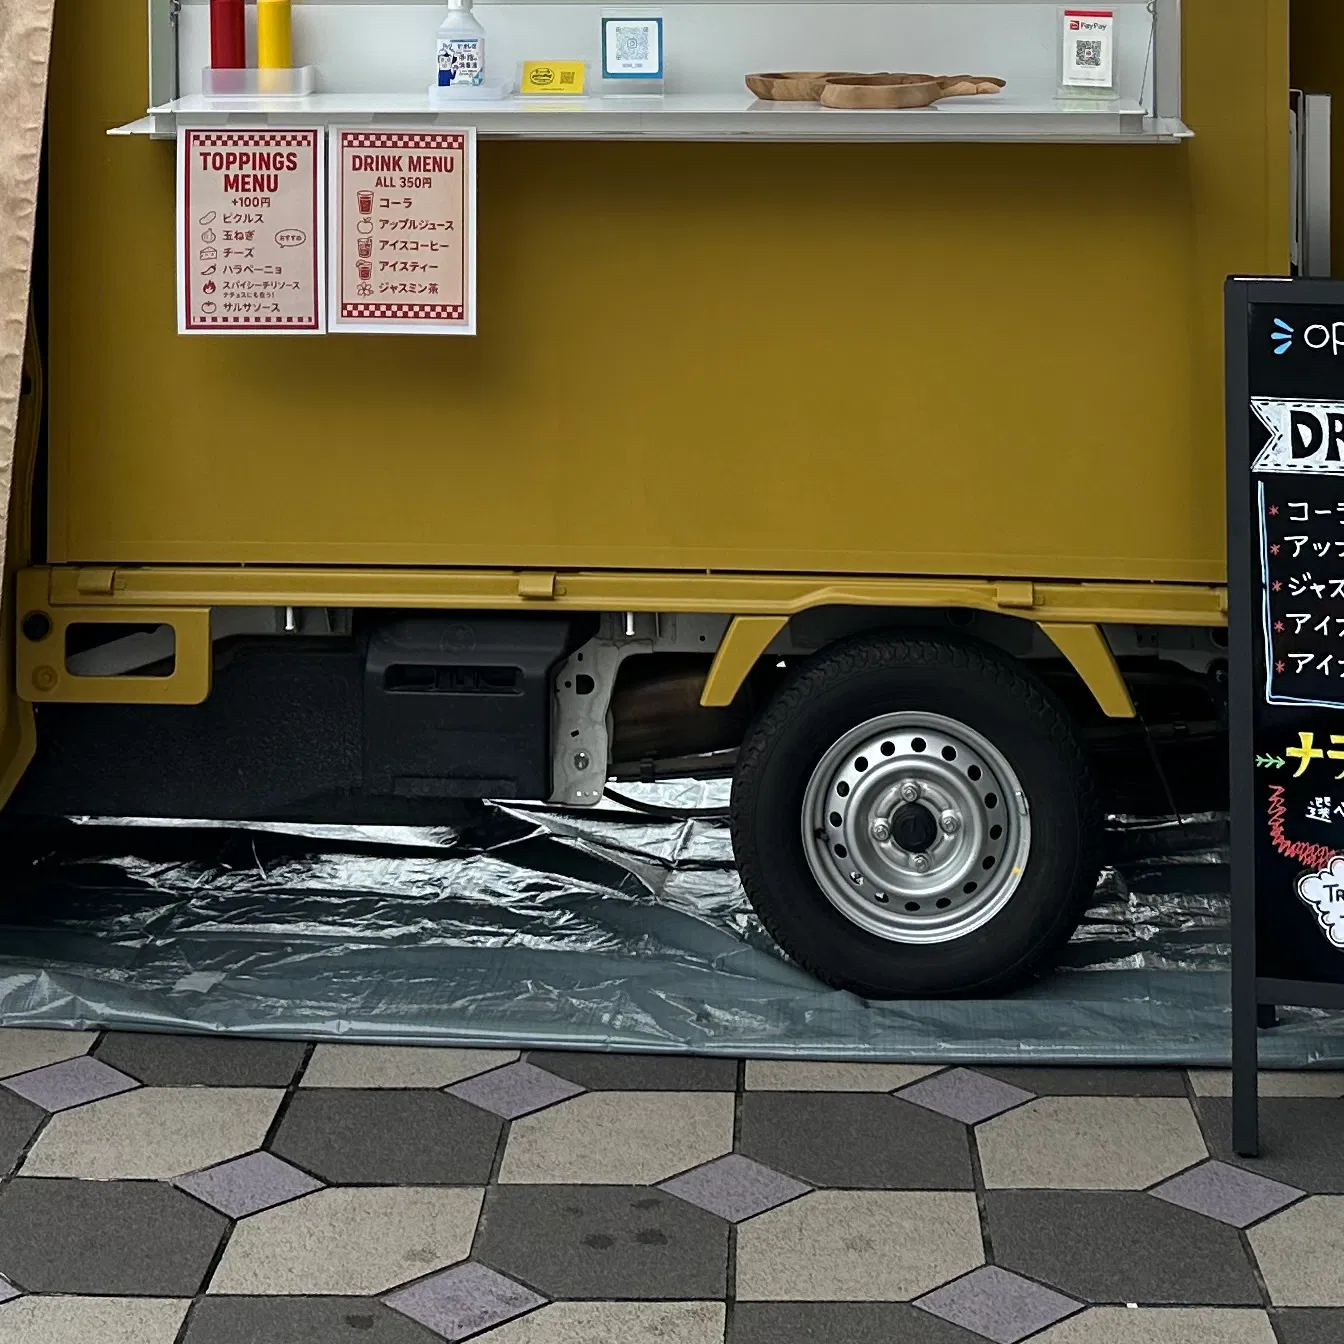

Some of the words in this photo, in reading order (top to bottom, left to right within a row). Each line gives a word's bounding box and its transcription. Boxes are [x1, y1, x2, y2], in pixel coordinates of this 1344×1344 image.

[199, 152, 297, 171] TOPPINGS
[352, 155, 402, 173] DRINK
[408, 155, 454, 173] MENU
[224, 174, 279, 193] MENU
[375, 177, 396, 188] ALL
[399, 177, 432, 189] 350円
[231, 197, 271, 208] +100円
[379, 197, 413, 209] コーラ
[223, 213, 264, 224] ピクルス
[379, 219, 454, 231] アップルジュース
[223, 229, 255, 241] 玉ねぎ
[379, 240, 449, 251] アイスコーヒー
[223, 247, 255, 258] チーズ
[223, 264, 282, 275] ハラペーニョ
[379, 261, 439, 272] アイスティー
[223, 281, 300, 290] スパイシーチリソース
[378, 282, 439, 295] ジャスミン茶
[223, 302, 280, 312] サルサソース
